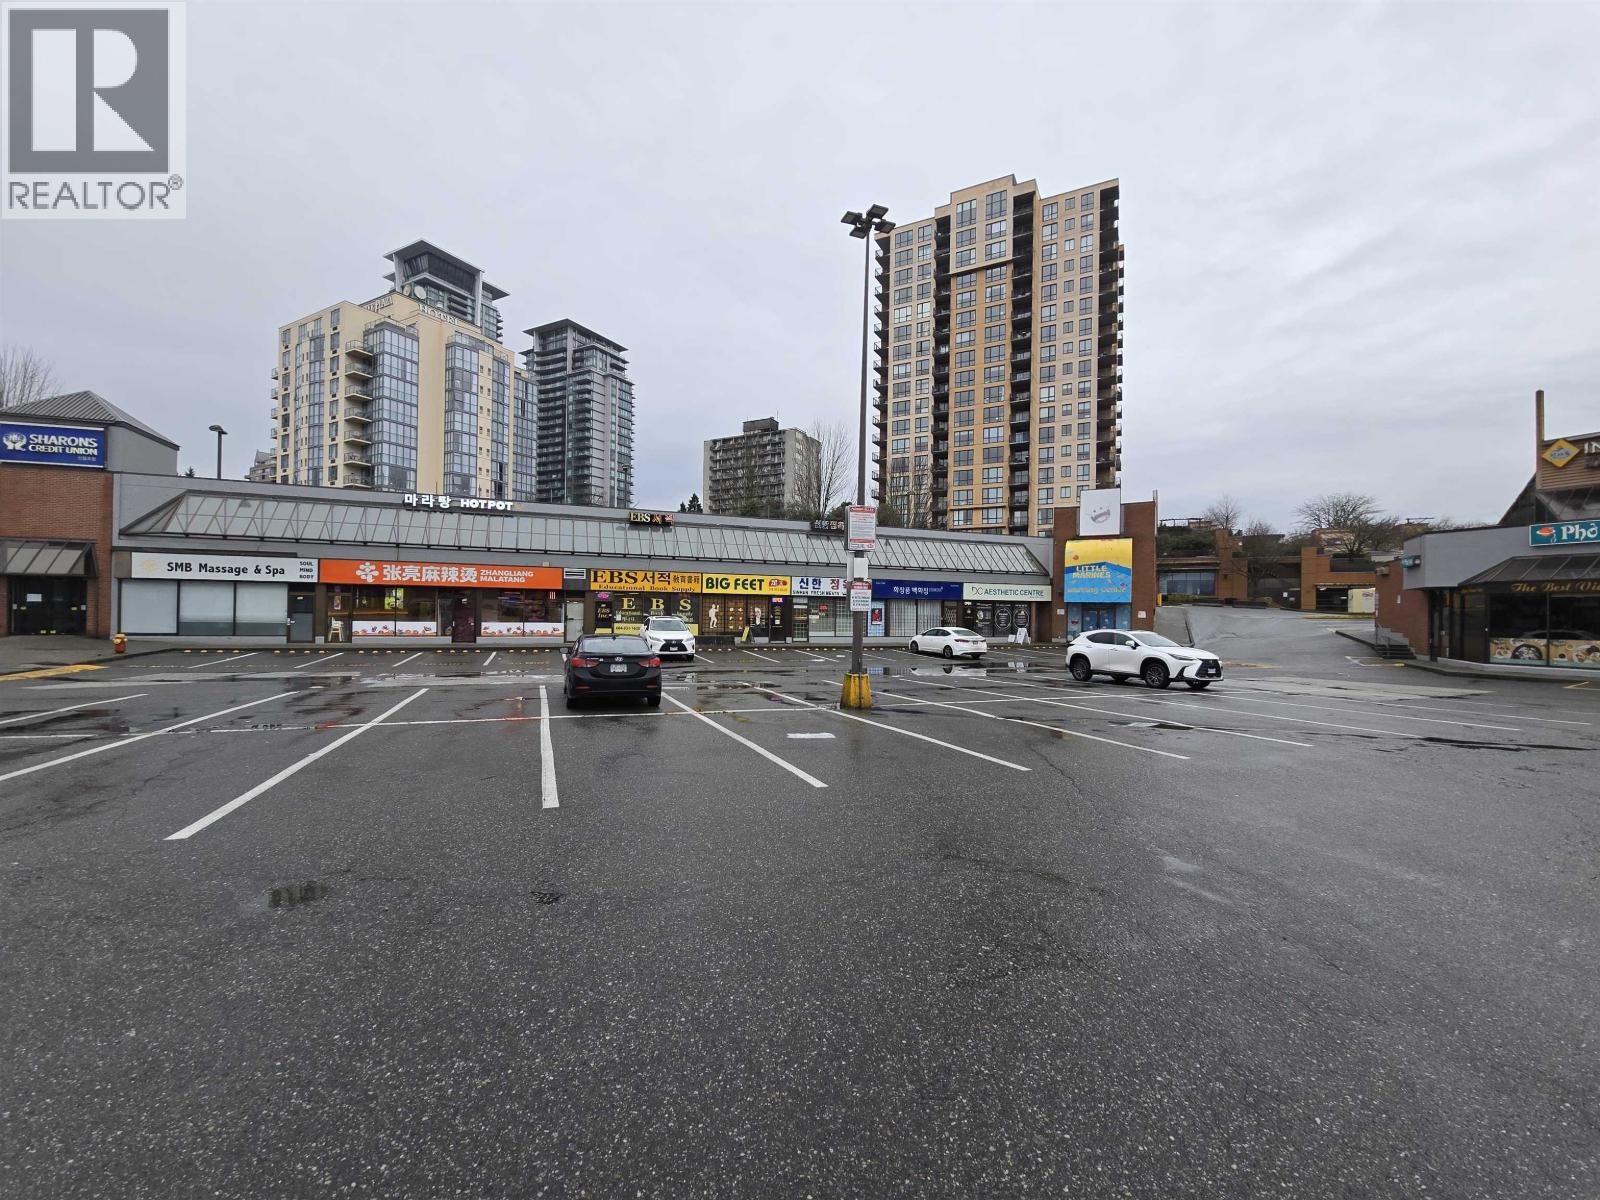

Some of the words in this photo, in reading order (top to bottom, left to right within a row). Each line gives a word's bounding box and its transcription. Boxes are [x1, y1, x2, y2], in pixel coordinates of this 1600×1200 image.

[29, 433, 98, 448] SHARONS
[28, 445, 63, 453] CREDIT
[65, 446, 98, 455] UNION
[404, 493, 452, 509] 마라탕
[460, 498, 514, 511] HOTPOT
[166, 561, 193, 572] SMB
[198, 563, 249, 576] Massage
[253, 565, 262, 574] &
[265, 565, 285, 577] Spa
[382, 564, 478, 583] 张亮麻辣烫
[480, 569, 534, 577] ZHANGLIANG
[480, 575, 526, 583] MALATANG
[705, 577, 731, 589] BIG
[734, 578, 764, 591] FEET
[984, 588, 1018, 596] AESTHETIC
[1020, 589, 1045, 597] CENTRE
[1512, 582, 1537, 592] The
[1541, 581, 1571, 592] Best
